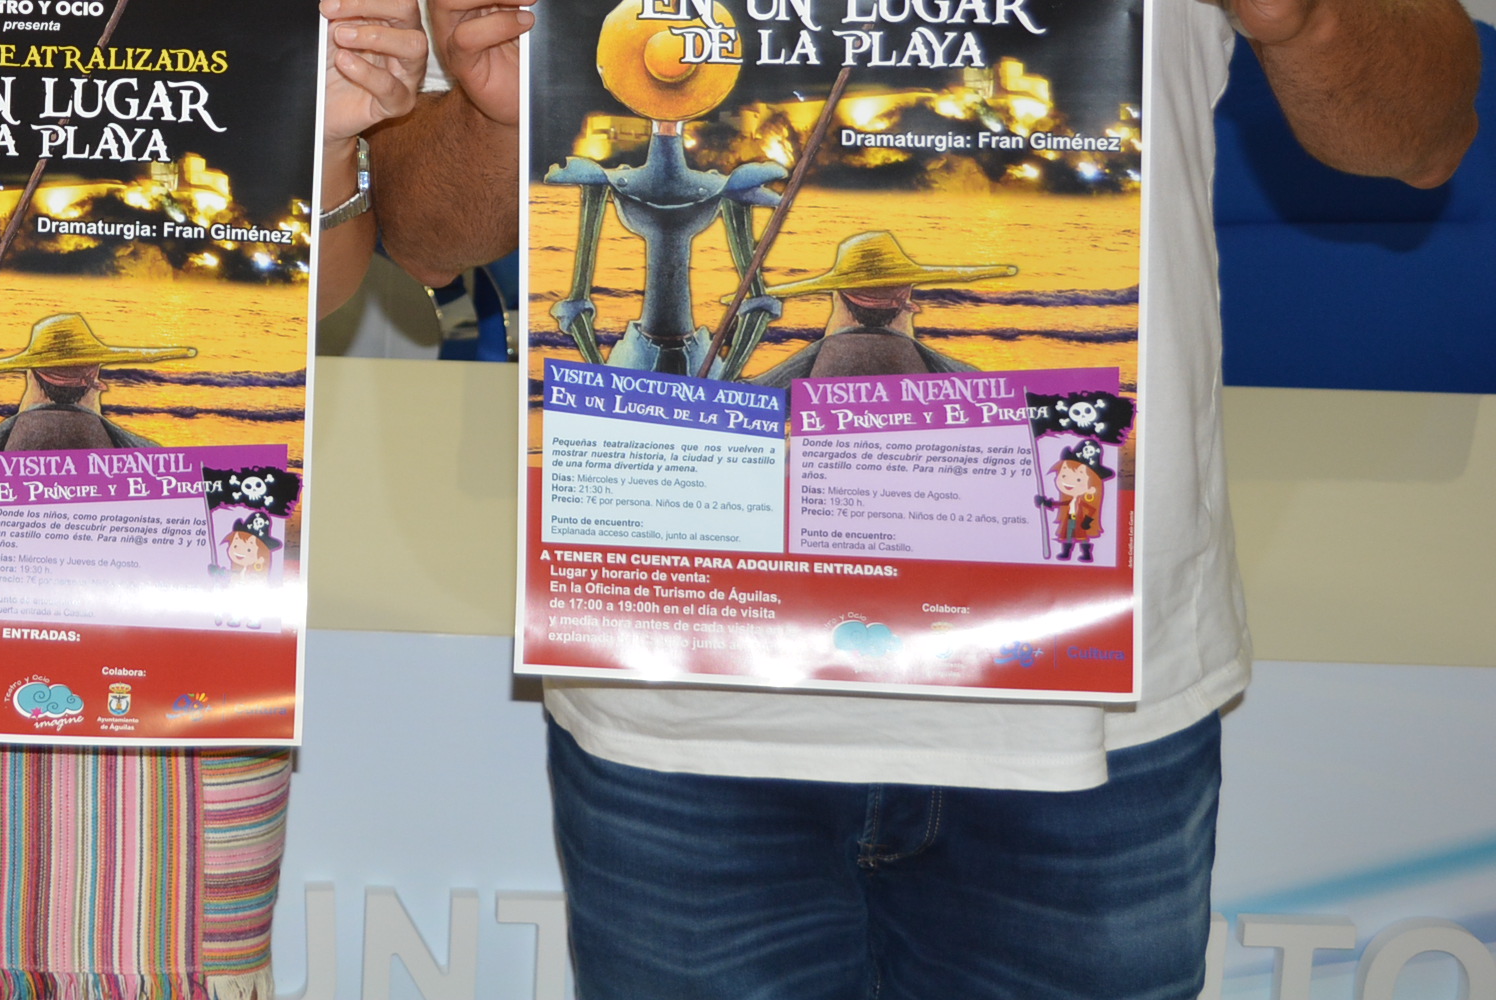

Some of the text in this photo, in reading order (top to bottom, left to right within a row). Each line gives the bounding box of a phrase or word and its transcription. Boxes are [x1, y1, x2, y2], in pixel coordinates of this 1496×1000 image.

[38, 0, 51, 15] Y
[56, 1, 104, 16] OCIO
[3, 19, 60, 32] presenta
[670, 27, 986, 68] DE LA PLAYA
[40, 77, 227, 132] LUGAR
[31, 122, 171, 162] PLAYA
[841, 130, 1121, 152] Dramaturgia: Fran Giménez
[37, 217, 292, 243] Dramaturgia: Fran Giménez
[551, 365, 779, 410] VISITA NOCTURNA ADULTA
[803, 377, 1015, 405] VISITA INFANTIL
[550, 386, 779, 433] EN UN LUGAR DE LA PLAYA
[800, 402, 1050, 431] EL PRÍNCIPE Y EL PIRATA
[803, 439, 833, 448] Donde
[836, 440, 850, 448] los
[854, 440, 882, 450] niños,
[915, 443, 984, 454] protagonistas,
[987, 445, 1013, 454] serán
[1017, 446, 1031, 455] los
[87, 452, 193, 478] INFANTIL
[23, 481, 102, 501] PRÍNCIPE
[108, 484, 117, 496] Y
[127, 478, 150, 497] EL
[156, 476, 223, 496] PIRATA
[922, 603, 970, 614] Colabora:
[3, 628, 80, 642] ENTRADAS:
[1067, 646, 1125, 660] Cultura
[102, 666, 146, 677] Colabora:
